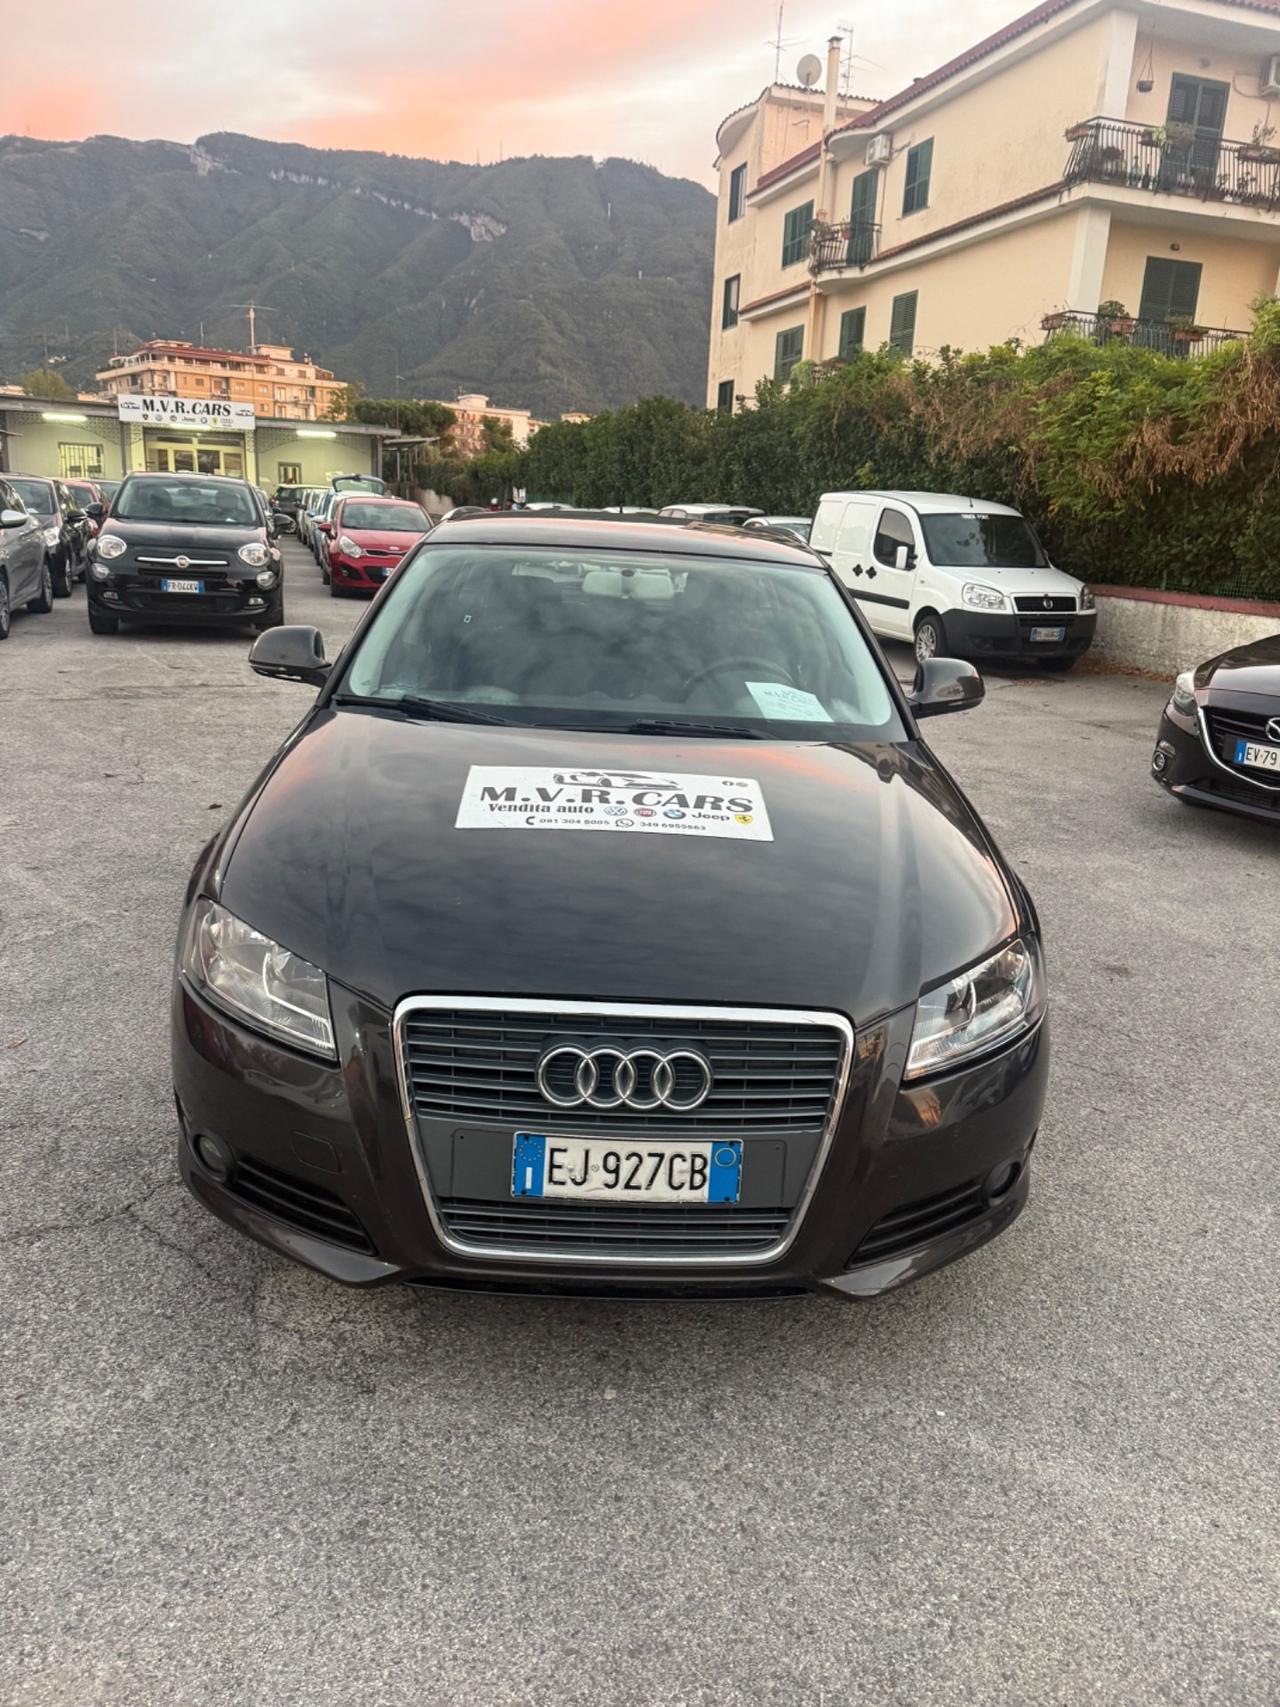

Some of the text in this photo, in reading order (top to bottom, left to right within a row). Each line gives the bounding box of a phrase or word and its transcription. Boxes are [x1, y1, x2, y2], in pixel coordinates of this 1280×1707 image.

[1246, 746, 1260, 762] EV
[488, 803, 595, 814] Vendita auto
[691, 812, 731, 822] Jeep
